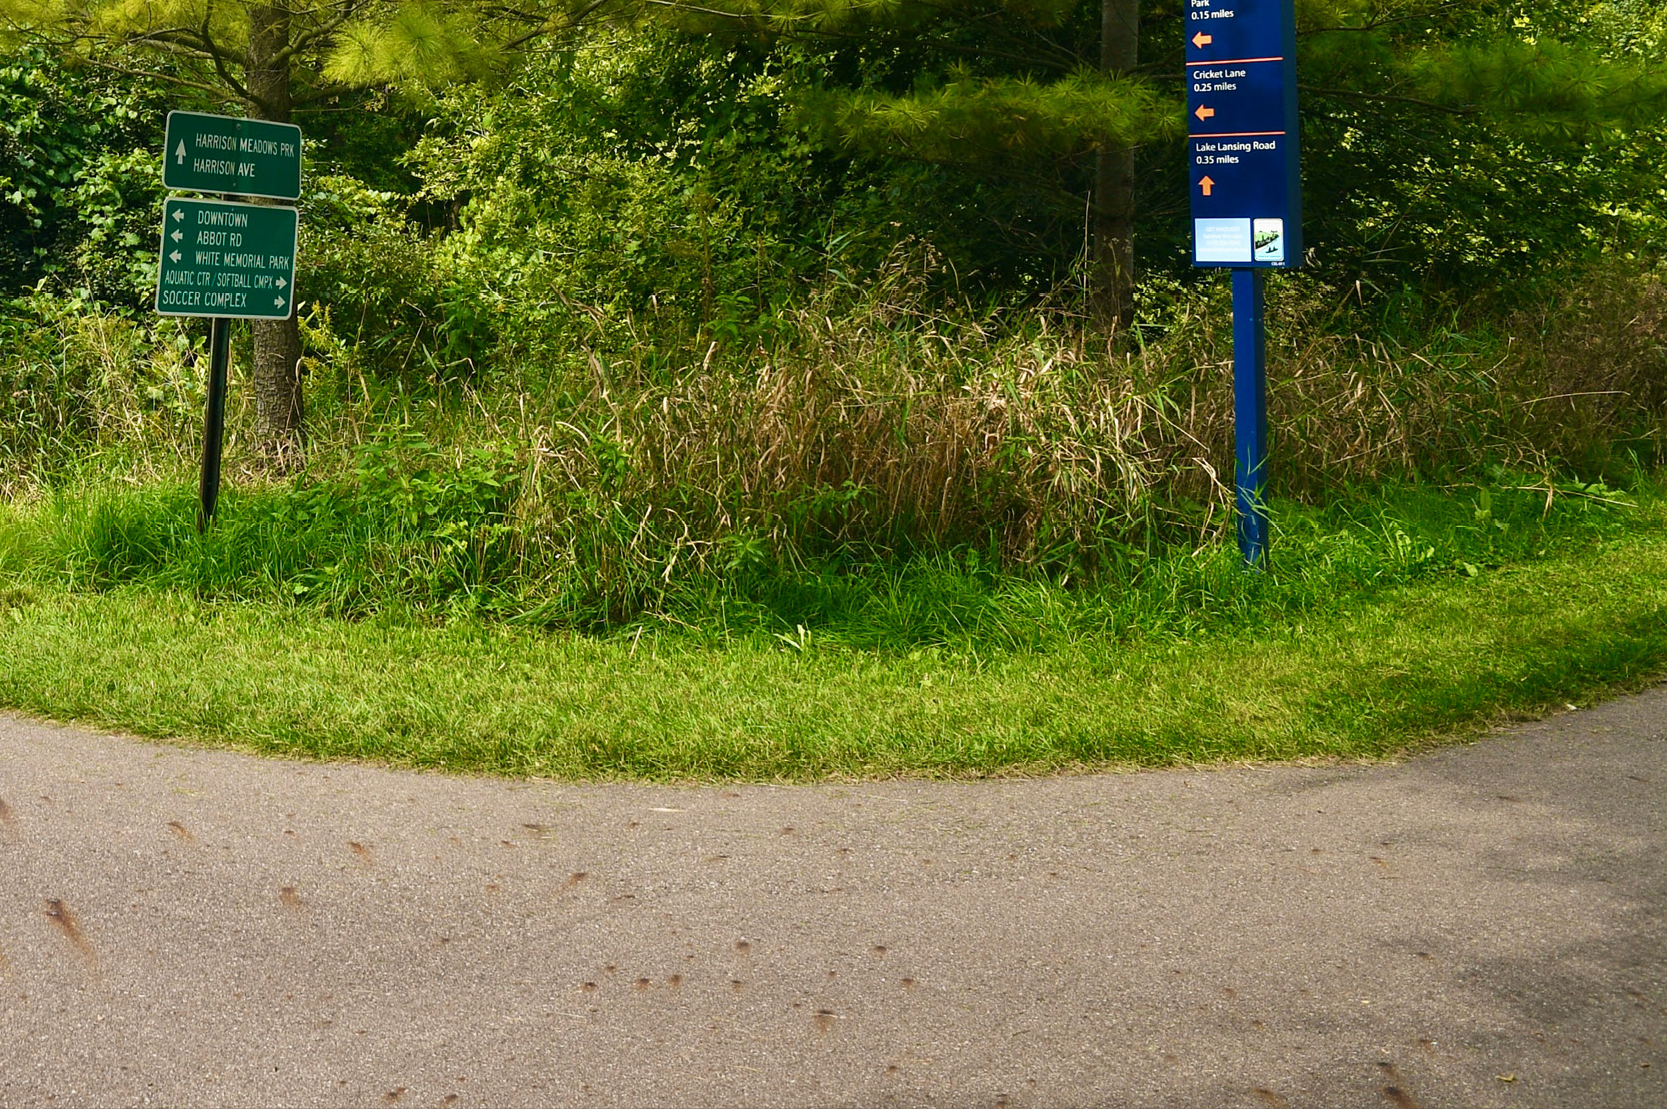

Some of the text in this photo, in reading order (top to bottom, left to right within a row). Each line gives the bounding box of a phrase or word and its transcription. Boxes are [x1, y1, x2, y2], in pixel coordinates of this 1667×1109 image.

[1192, 9, 1234, 20] 0.15 miles
[1193, 69, 1246, 79] Cricket Lane
[1194, 82, 1236, 92] 0.25 miles
[196, 133, 295, 157] HARRISON MEADOWS PRK
[1196, 141, 1275, 152] Lake Lansing Road
[1196, 155, 1239, 164] 0.35 miles
[194, 159, 255, 177] HARRISON AVE
[198, 210, 247, 227] DOWNTOWN
[197, 231, 242, 246] ABBOT RD
[196, 251, 289, 270] WHITE MEMORIAL PARK
[165, 270, 194, 285] AQUATIC
[254, 275, 273, 289] CMPX
[163, 290, 247, 307] SOCCER COMPLEX
